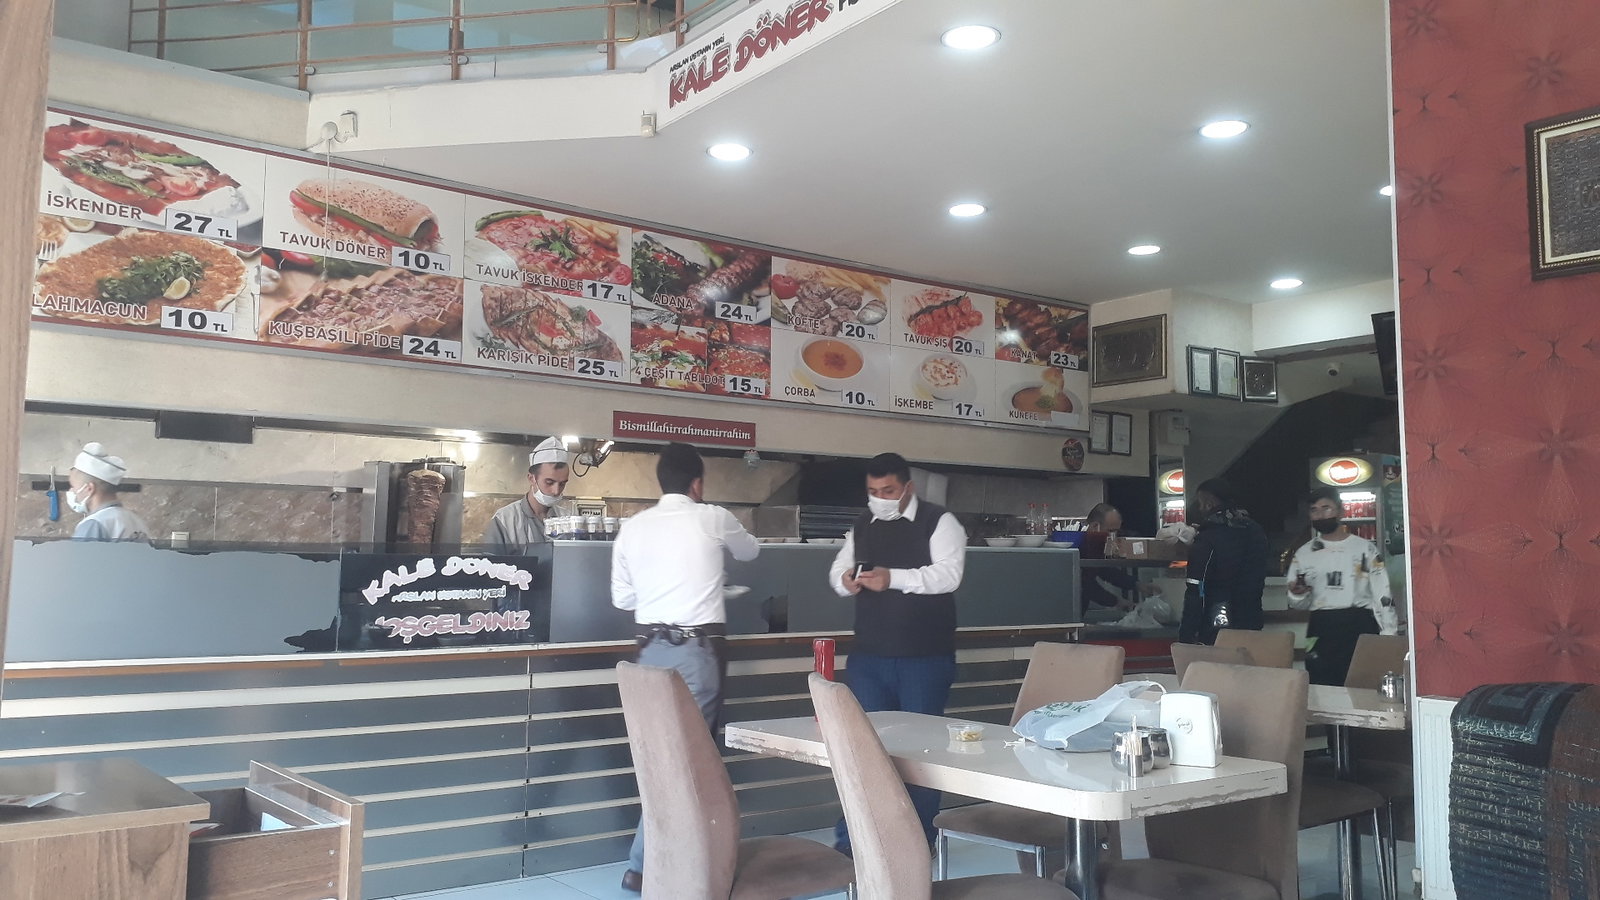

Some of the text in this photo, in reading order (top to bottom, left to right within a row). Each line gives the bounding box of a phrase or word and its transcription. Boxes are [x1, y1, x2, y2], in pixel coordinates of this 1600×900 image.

[669, 0, 834, 109] KALE DÖNER
[46, 190, 143, 221] İSKENDER
[173, 212, 233, 238] 27 TL
[279, 231, 388, 259] TAVUK DÖNER
[398, 250, 446, 271] 10 TL
[476, 264, 584, 292] TAVUK İSKENDER
[587, 282, 627, 302] 17 TL
[652, 293, 694, 310] ADANA
[32, 293, 149, 321] LAHMACUN
[720, 303, 753, 322] 24 TL
[168, 309, 228, 333] 10 TL
[269, 320, 402, 350] KUŞBAŞILI PİDE
[845, 324, 866, 339] 20
[904, 333, 933, 346] TAVUK
[408, 338, 457, 359] 24 TL
[955, 340, 973, 353] 20
[1011, 349, 1038, 360] KANAT
[477, 347, 569, 369] KARIŞIK PİDE
[577, 358, 619, 378] 25 TL
[1053, 353, 1069, 366] 23
[635, 366, 642, 376] 4
[729, 377, 763, 394] 15 TL
[784, 386, 816, 398] ÇORBA
[845, 391, 866, 405] 10
[955, 403, 973, 416] 17
[619, 419, 751, 440] Bismillahirrahmanirrahim
[362, 557, 437, 606] KALE
